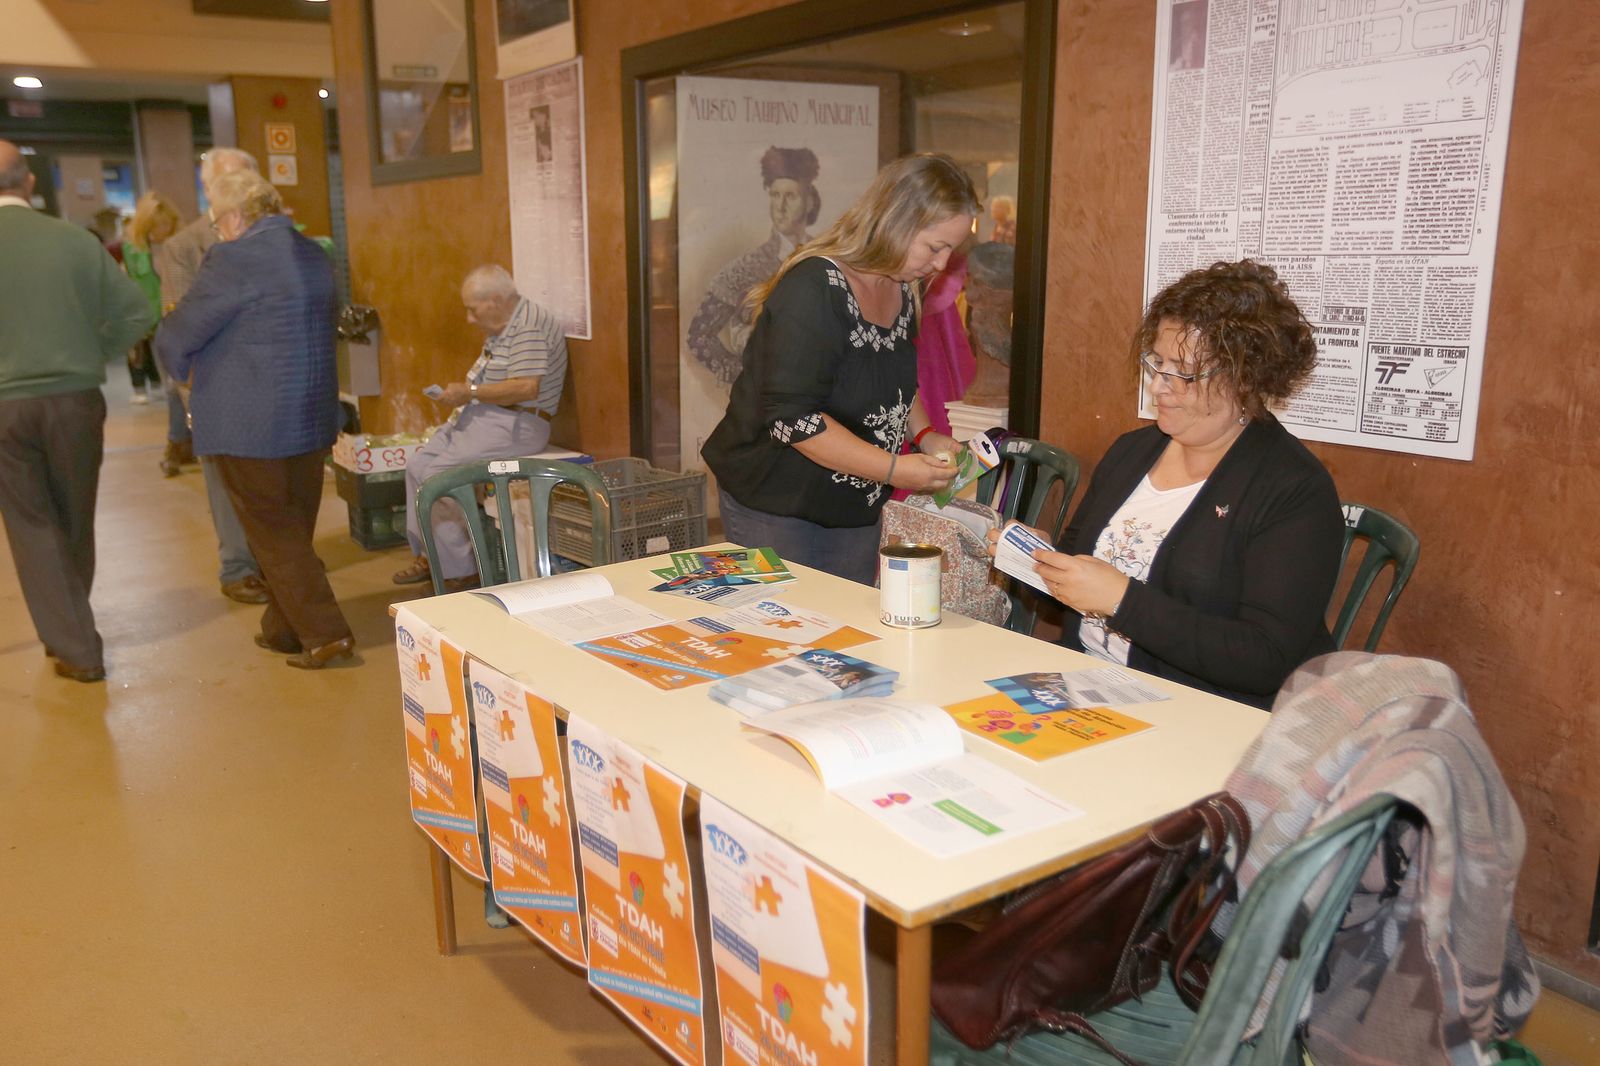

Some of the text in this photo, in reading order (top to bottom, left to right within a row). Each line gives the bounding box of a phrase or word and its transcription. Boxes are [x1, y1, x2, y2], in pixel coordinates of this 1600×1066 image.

[687, 93, 736, 121] MUSEO
[806, 99, 872, 126] MUNICIPAL
[1328, 339, 1359, 347] FRONTERA
[1371, 345, 1466, 359] PUENTE MARITIMO DEL ESTRECHO
[680, 636, 732, 659] TDAH
[424, 747, 453, 785] TDAH
[509, 817, 547, 859] TDAH
[615, 894, 664, 949] TDAH
